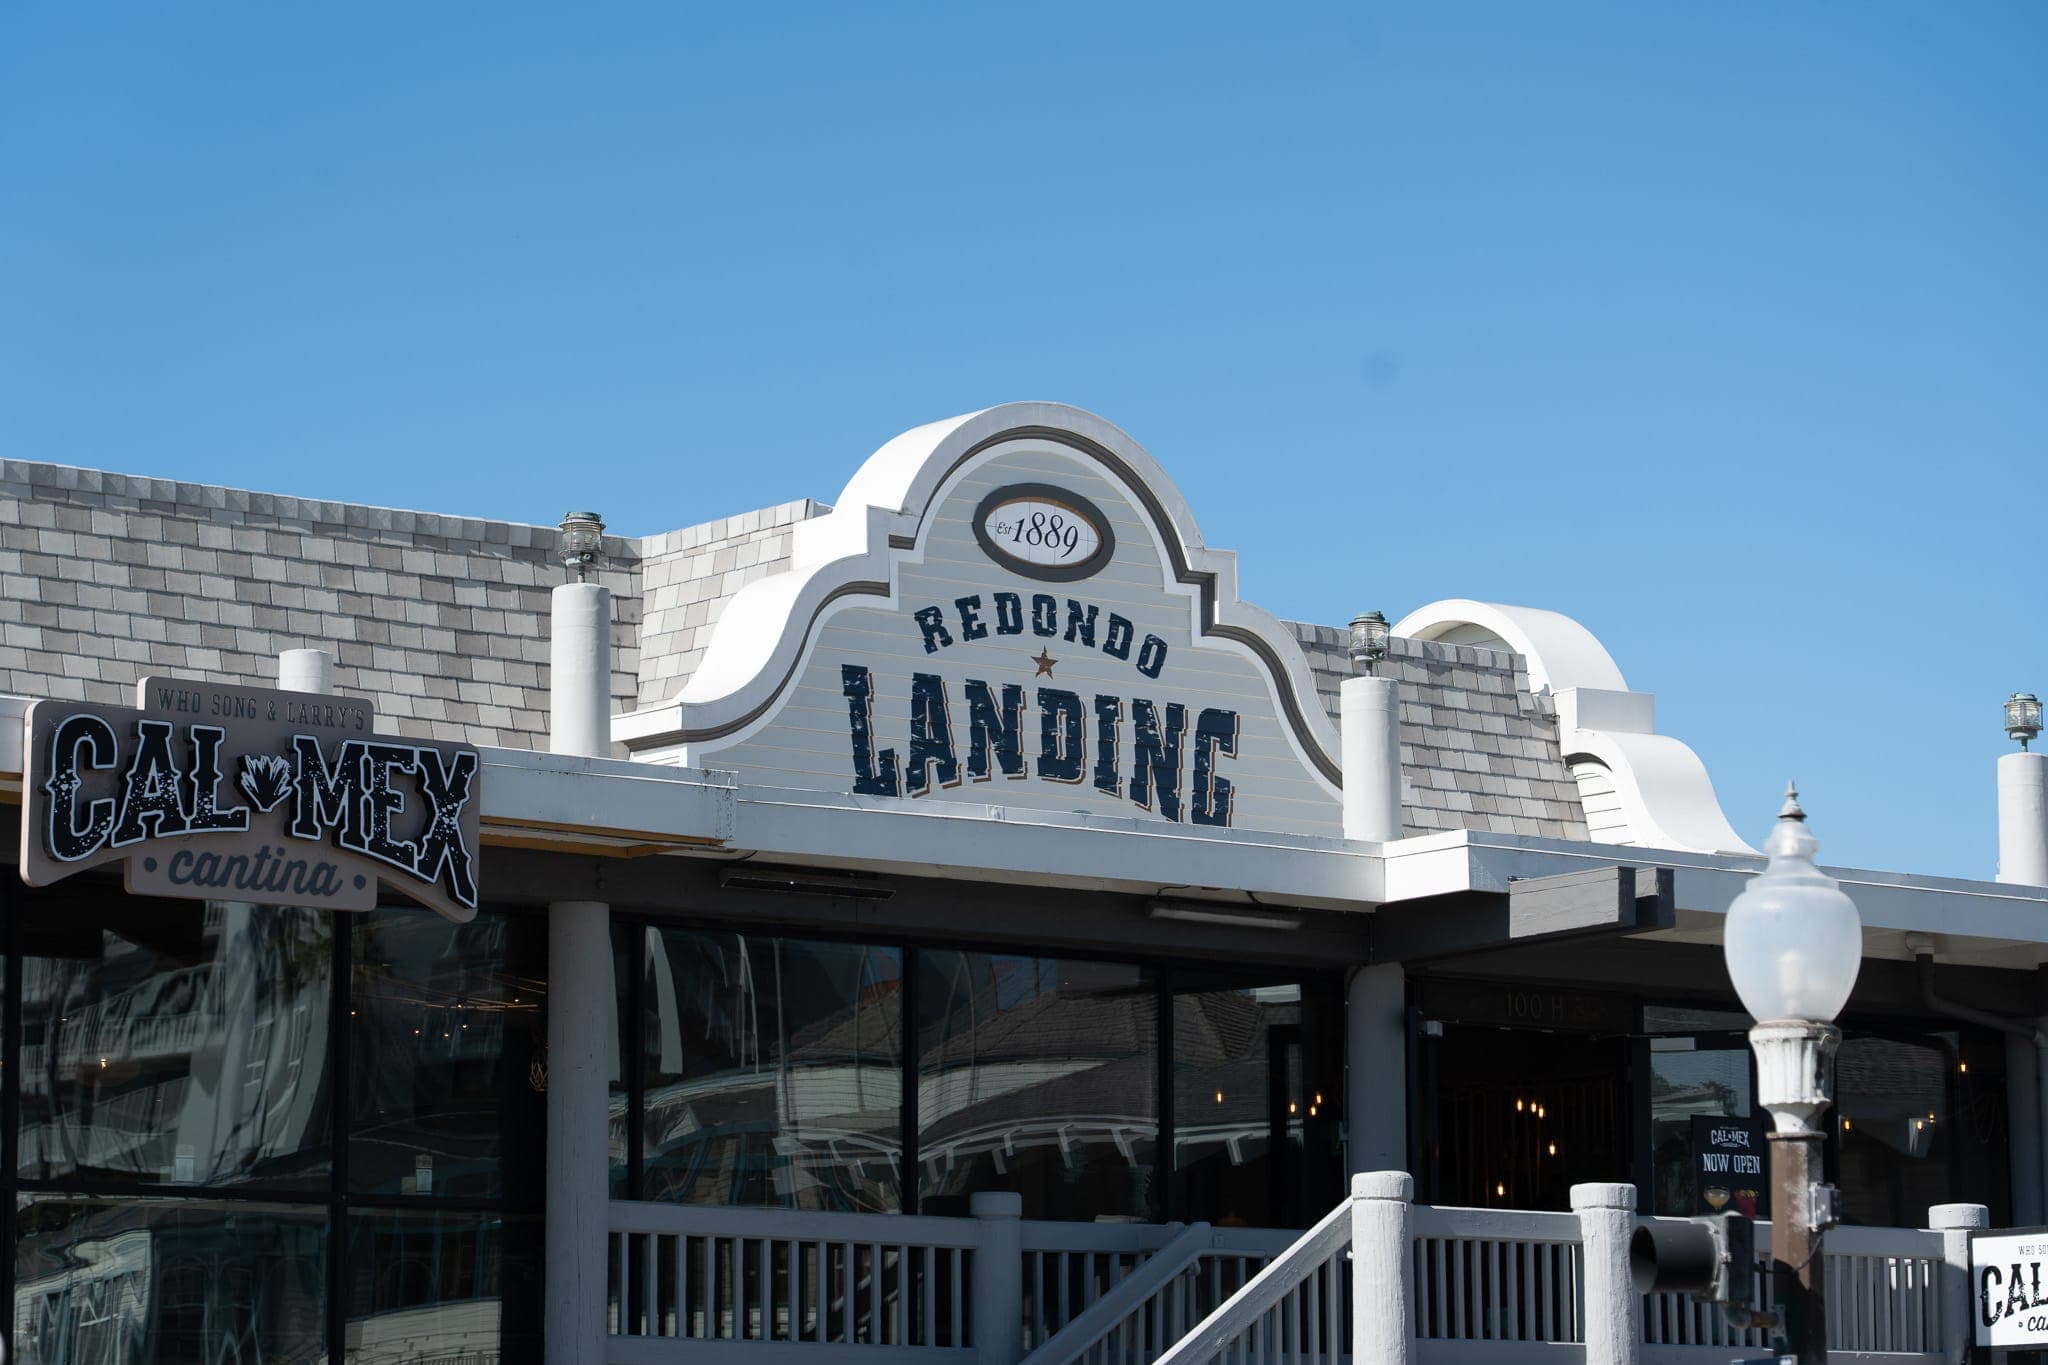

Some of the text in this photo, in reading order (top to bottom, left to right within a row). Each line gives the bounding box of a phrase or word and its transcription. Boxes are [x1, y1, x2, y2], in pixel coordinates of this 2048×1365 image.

[997, 511, 1078, 558] Est 1889
[914, 592, 1167, 679] REDONDO
[157, 688, 364, 730] WHO SONG & LARRY'S
[841, 663, 1239, 828] LANDING
[46, 714, 479, 908] CAL MEX
[168, 845, 343, 896] cantina
[1703, 1153, 1760, 1174] NOW OPEN
